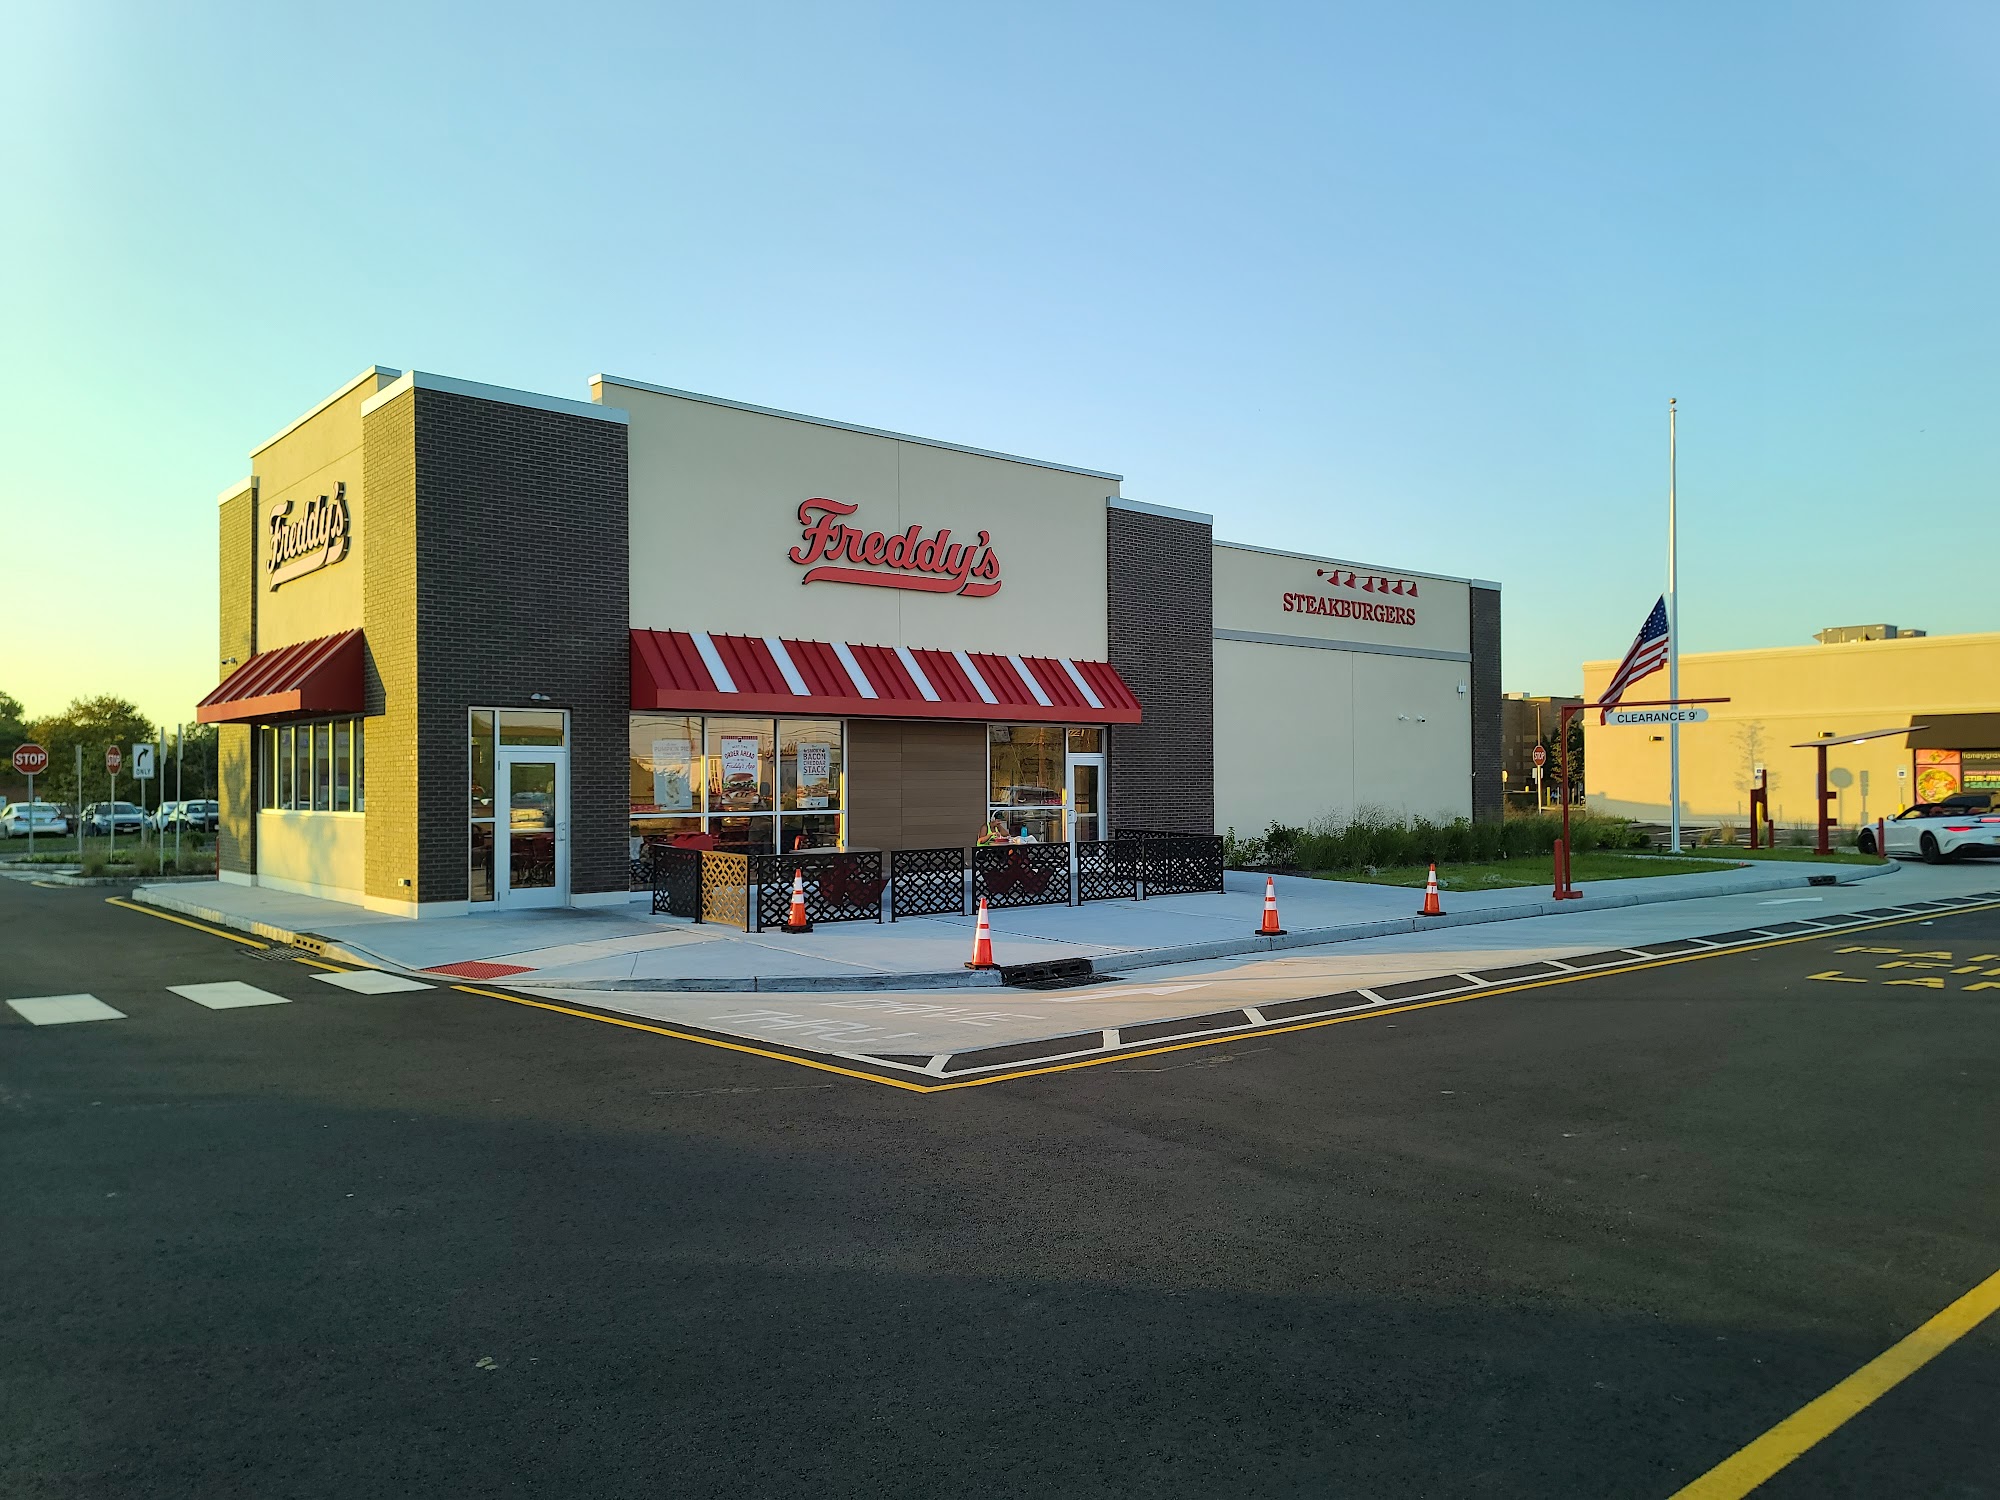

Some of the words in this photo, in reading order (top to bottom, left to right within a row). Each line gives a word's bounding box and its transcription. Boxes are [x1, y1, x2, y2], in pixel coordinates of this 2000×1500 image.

[266, 481, 351, 592] Freddy's
[787, 497, 1002, 597] Freddy's
[1283, 592, 1416, 626] STEAKBURGERS
[1617, 711, 1685, 723] CLEARANCE
[15, 753, 46, 765] STOP
[107, 754, 121, 767] STOP
[1534, 752, 1545, 760] STOP
[819, 999, 1044, 1026] DRIVE
[708, 1010, 918, 1043] THRU
